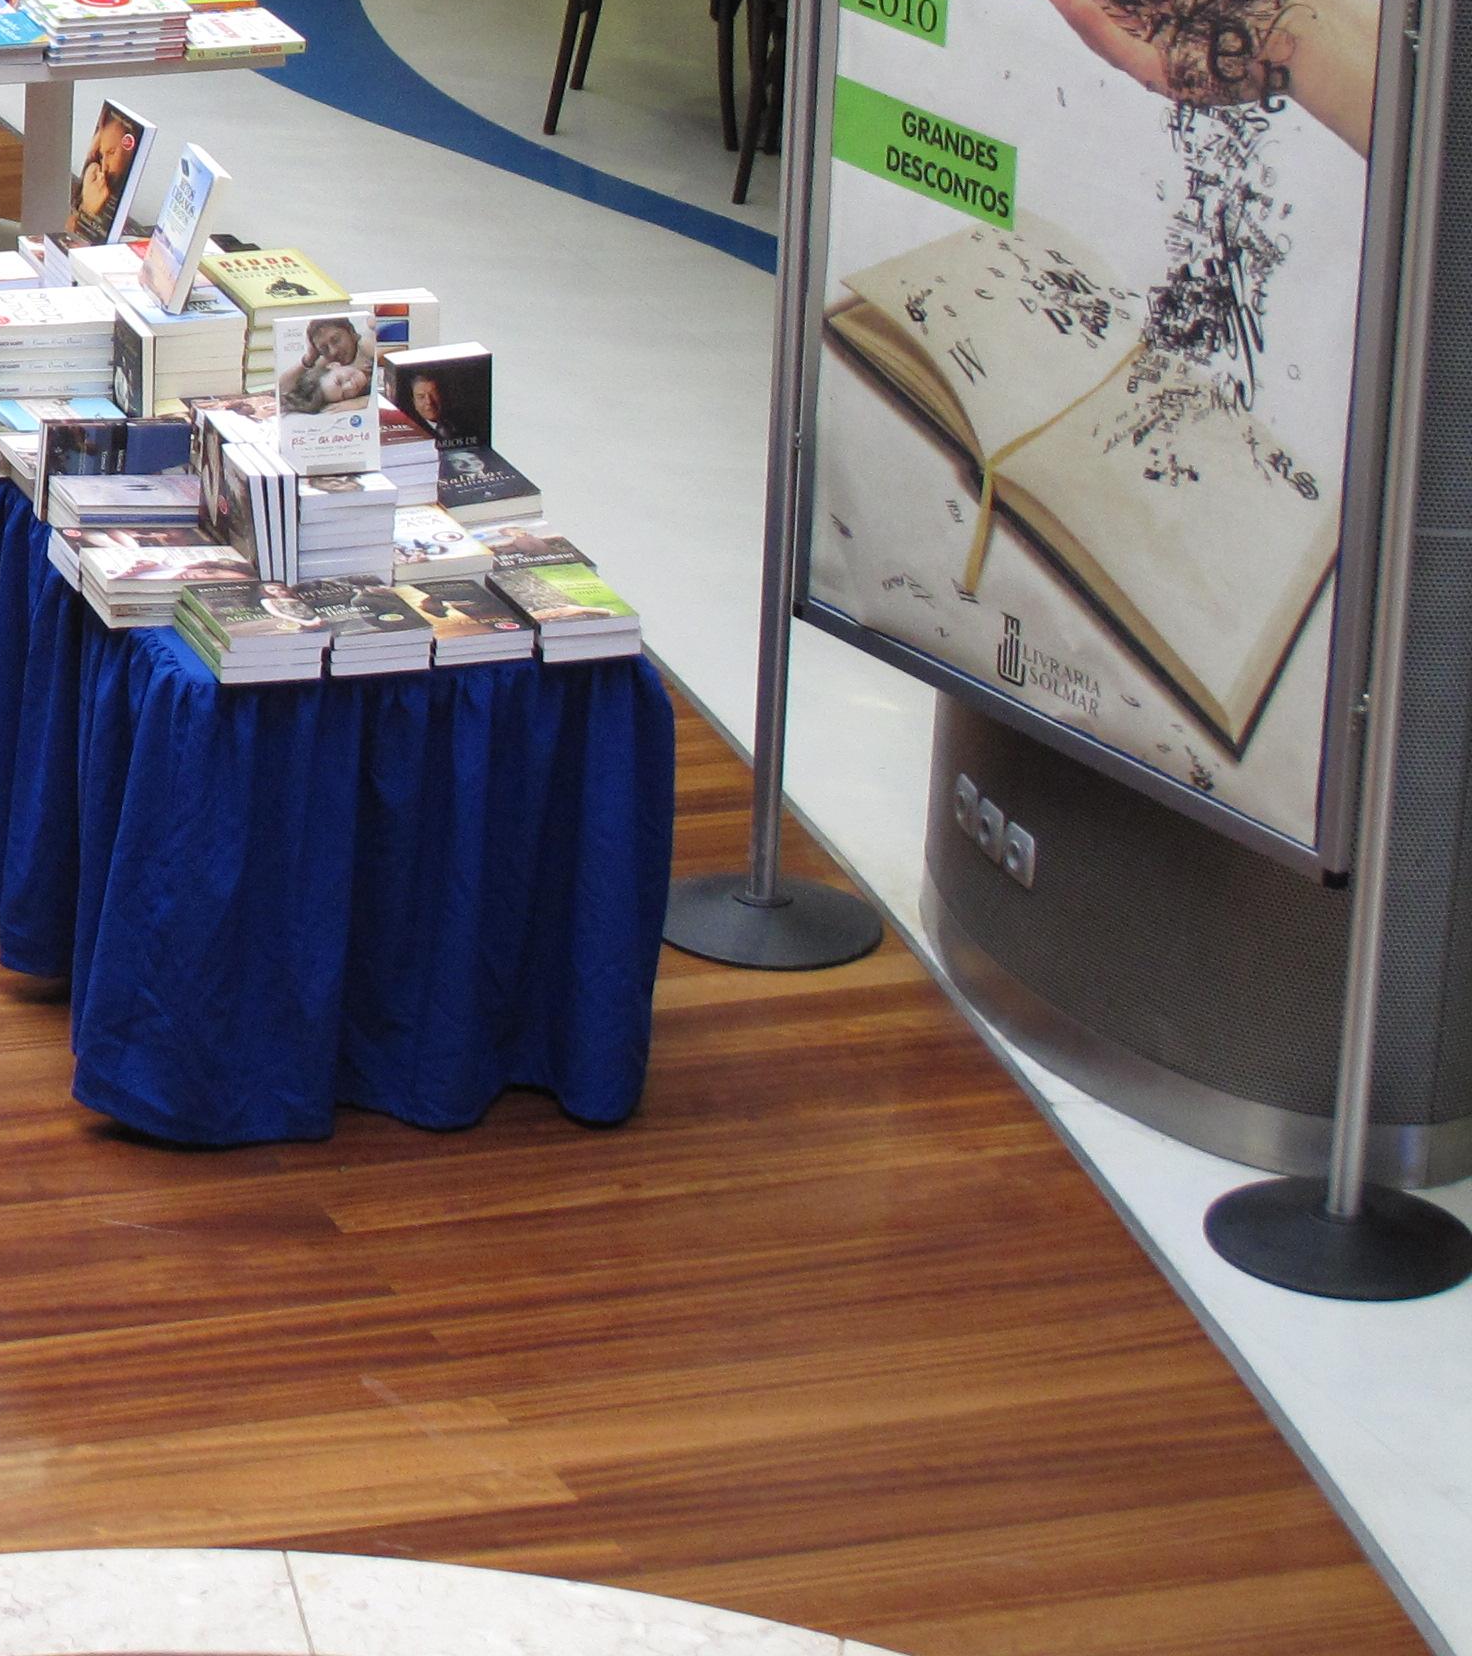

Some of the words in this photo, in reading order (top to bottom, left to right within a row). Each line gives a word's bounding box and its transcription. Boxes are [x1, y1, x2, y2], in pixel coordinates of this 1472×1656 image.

[901, 111, 998, 172] GRANDES
[886, 145, 1009, 219] DESCONTOS
[265, 255, 295, 265] DA
[1023, 644, 1101, 698] LIVRARIA
[1028, 666, 1098, 717] SOLMAR
